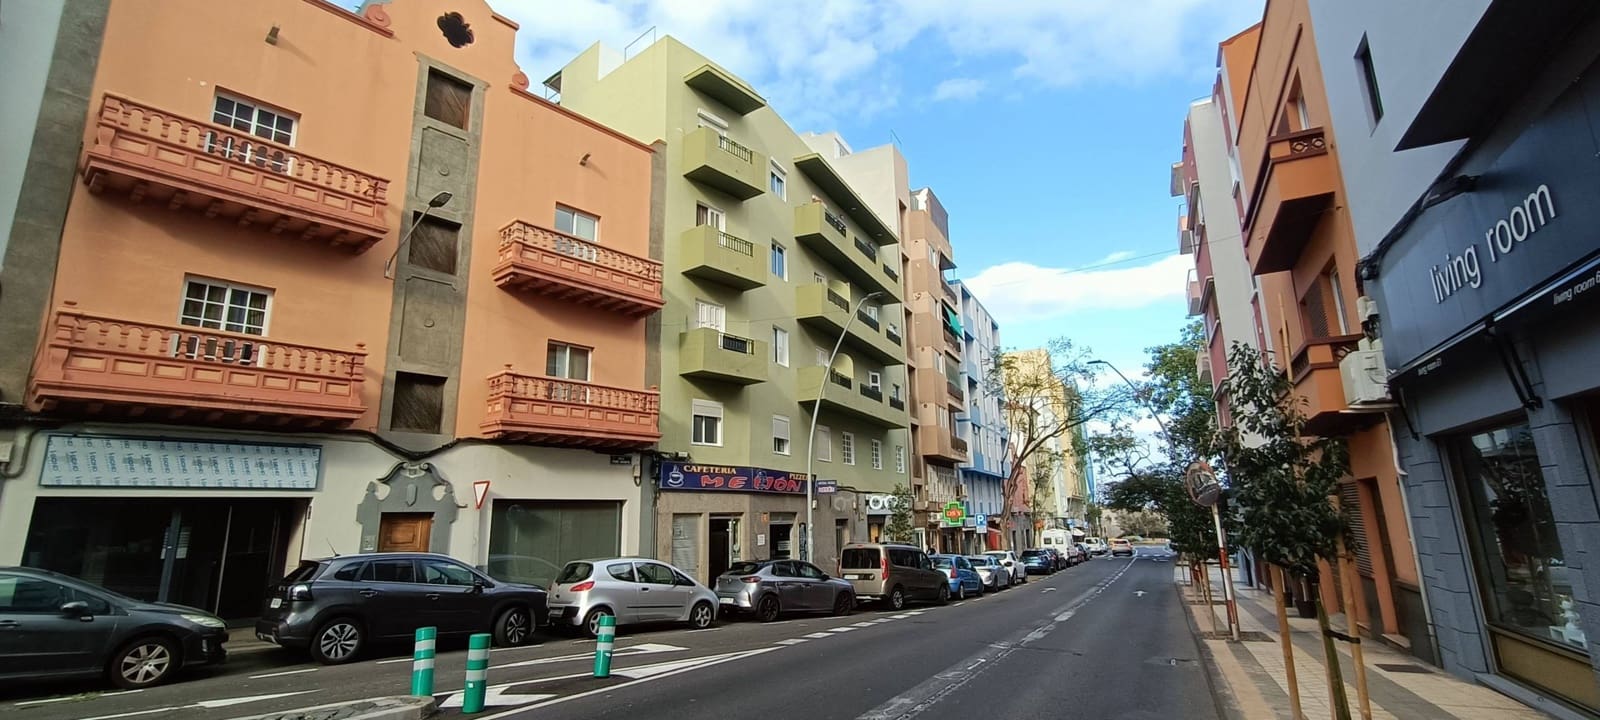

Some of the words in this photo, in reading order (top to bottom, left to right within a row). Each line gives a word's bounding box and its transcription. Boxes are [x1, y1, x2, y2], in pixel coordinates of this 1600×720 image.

[1429, 244, 1482, 304] living
[1485, 183, 1556, 263] room
[683, 464, 736, 474] CAFETERIA
[977, 514, 984, 525] P
